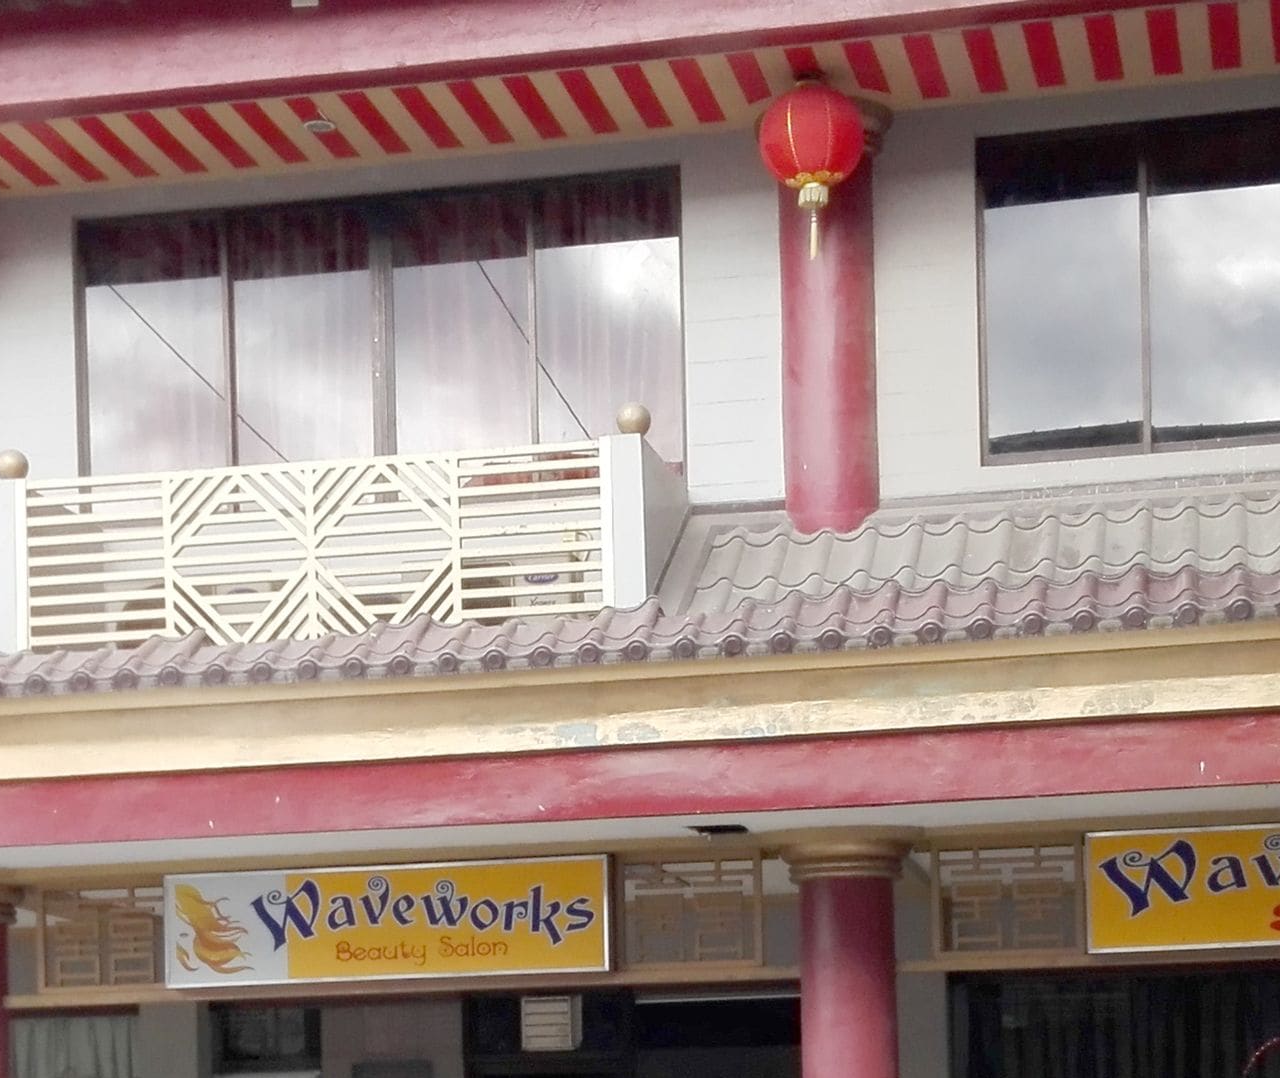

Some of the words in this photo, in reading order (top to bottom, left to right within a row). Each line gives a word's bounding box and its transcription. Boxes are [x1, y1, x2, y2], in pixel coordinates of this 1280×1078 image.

[250, 875, 597, 953] Waveworks
[335, 940, 428, 966] Beauty
[437, 935, 509, 958] Salon
